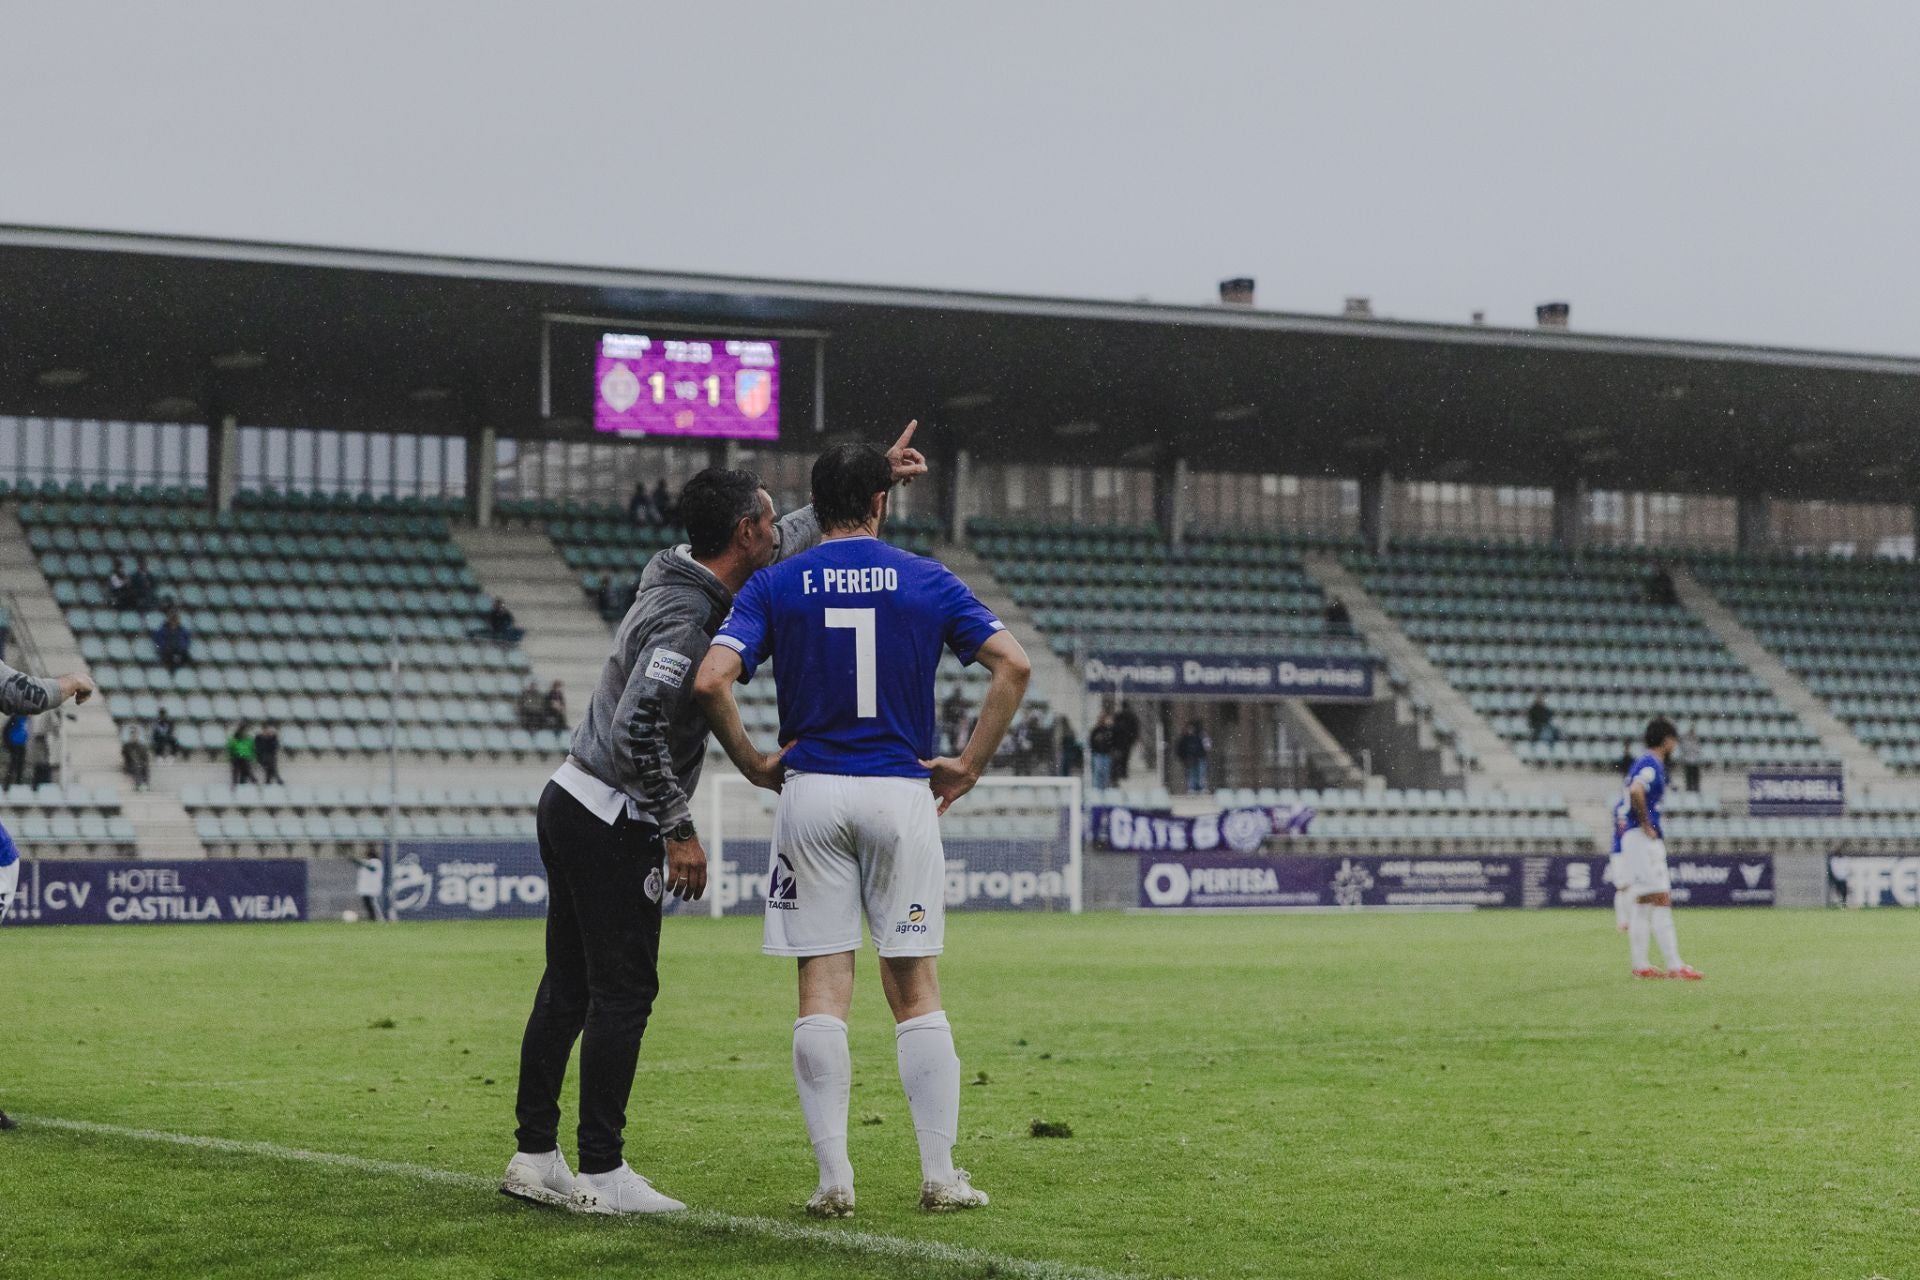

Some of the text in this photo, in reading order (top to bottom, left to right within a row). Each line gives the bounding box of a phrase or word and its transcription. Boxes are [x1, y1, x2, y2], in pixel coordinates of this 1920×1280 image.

[648, 372, 665, 404] 1
[704, 375, 720, 407] 1
[803, 567, 898, 595] F. PEREDO
[824, 607, 877, 718] 7
[1085, 659, 1365, 688] Danisa Danisa Danisa
[1109, 807, 1188, 850] GATE
[107, 868, 186, 894] HOTEL
[437, 875, 547, 911] agro
[1191, 867, 1279, 894] PERTESA
[43, 881, 91, 910] CV
[106, 895, 299, 922] CASTILLA VIEJA
